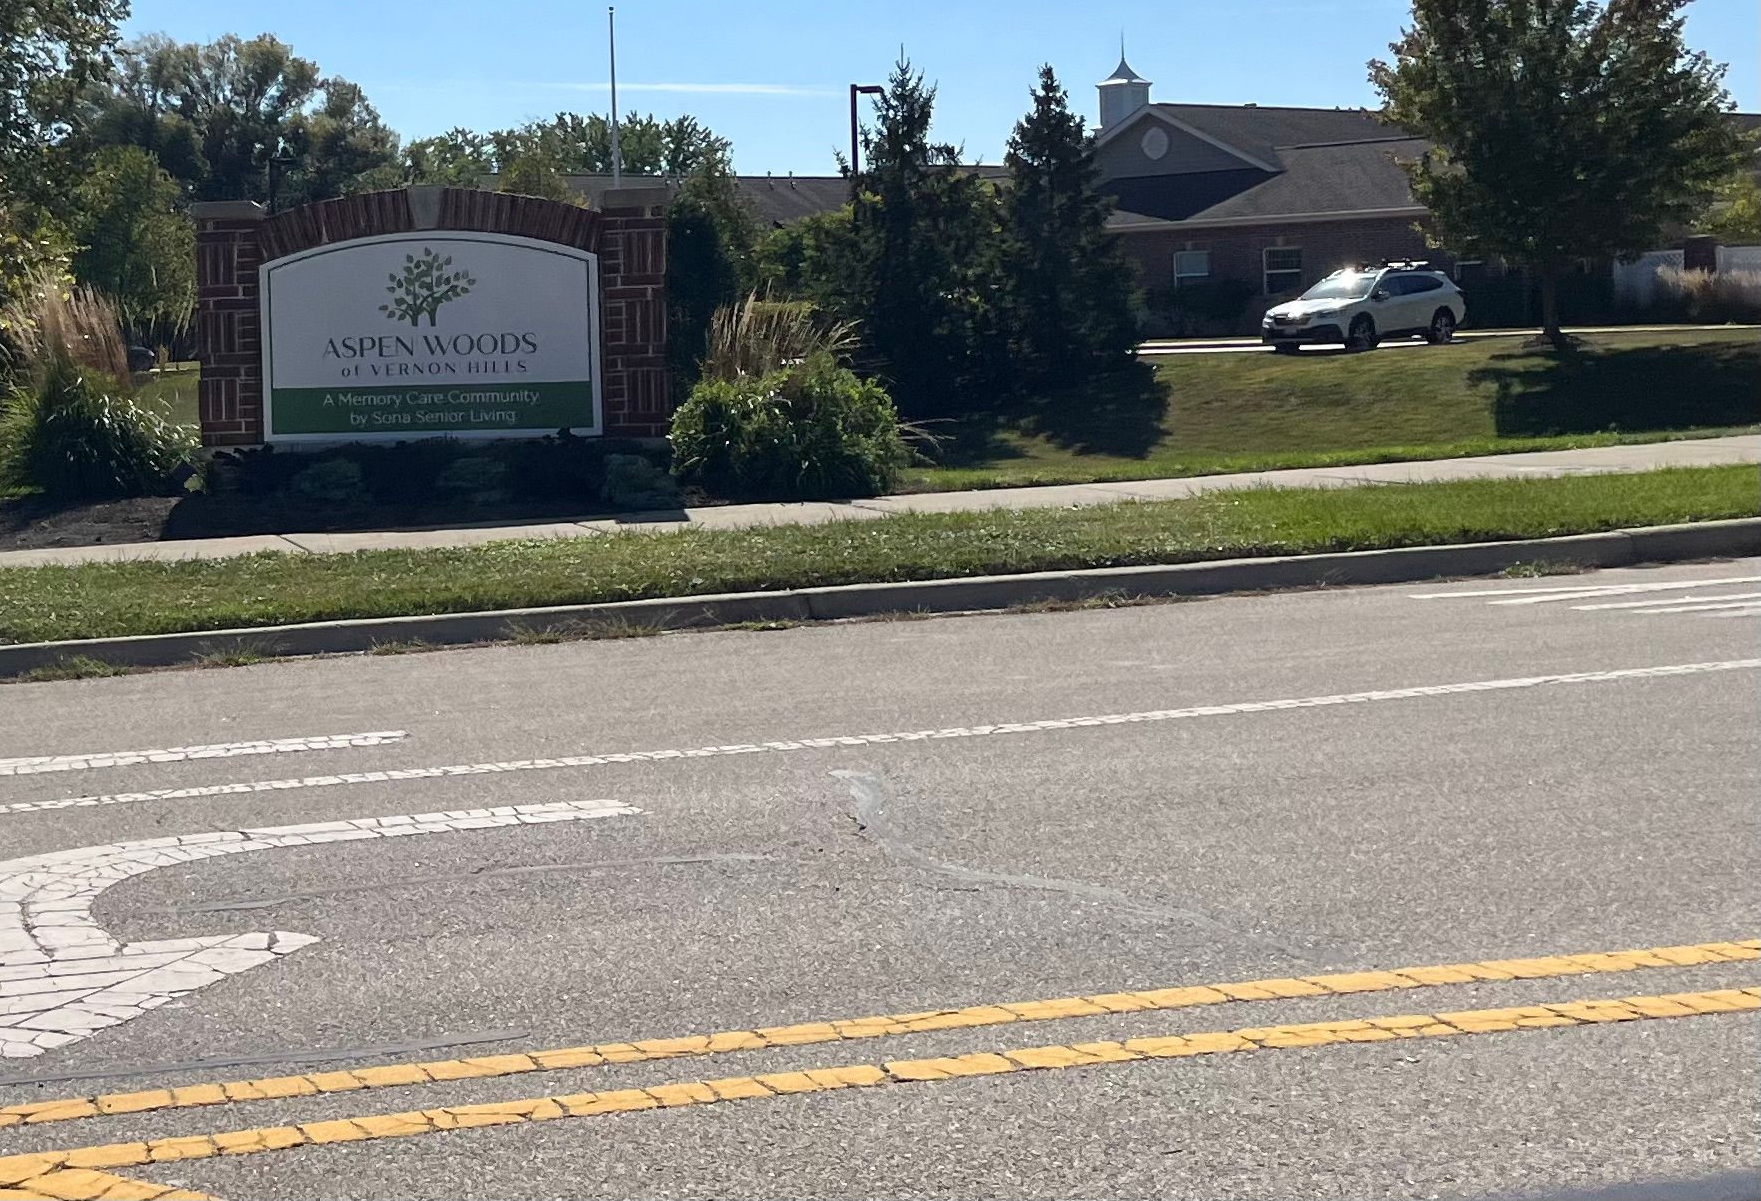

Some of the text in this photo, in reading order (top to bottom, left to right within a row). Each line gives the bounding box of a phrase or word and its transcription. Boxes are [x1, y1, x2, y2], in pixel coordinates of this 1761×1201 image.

[322, 332, 538, 359] ASPEN WOODS
[341, 359, 527, 378] of VERNON HILLS
[322, 388, 541, 409] A Memory Care Community
[350, 411, 368, 426] by
[415, 410, 465, 424] Senior
[470, 408, 518, 427] Living
